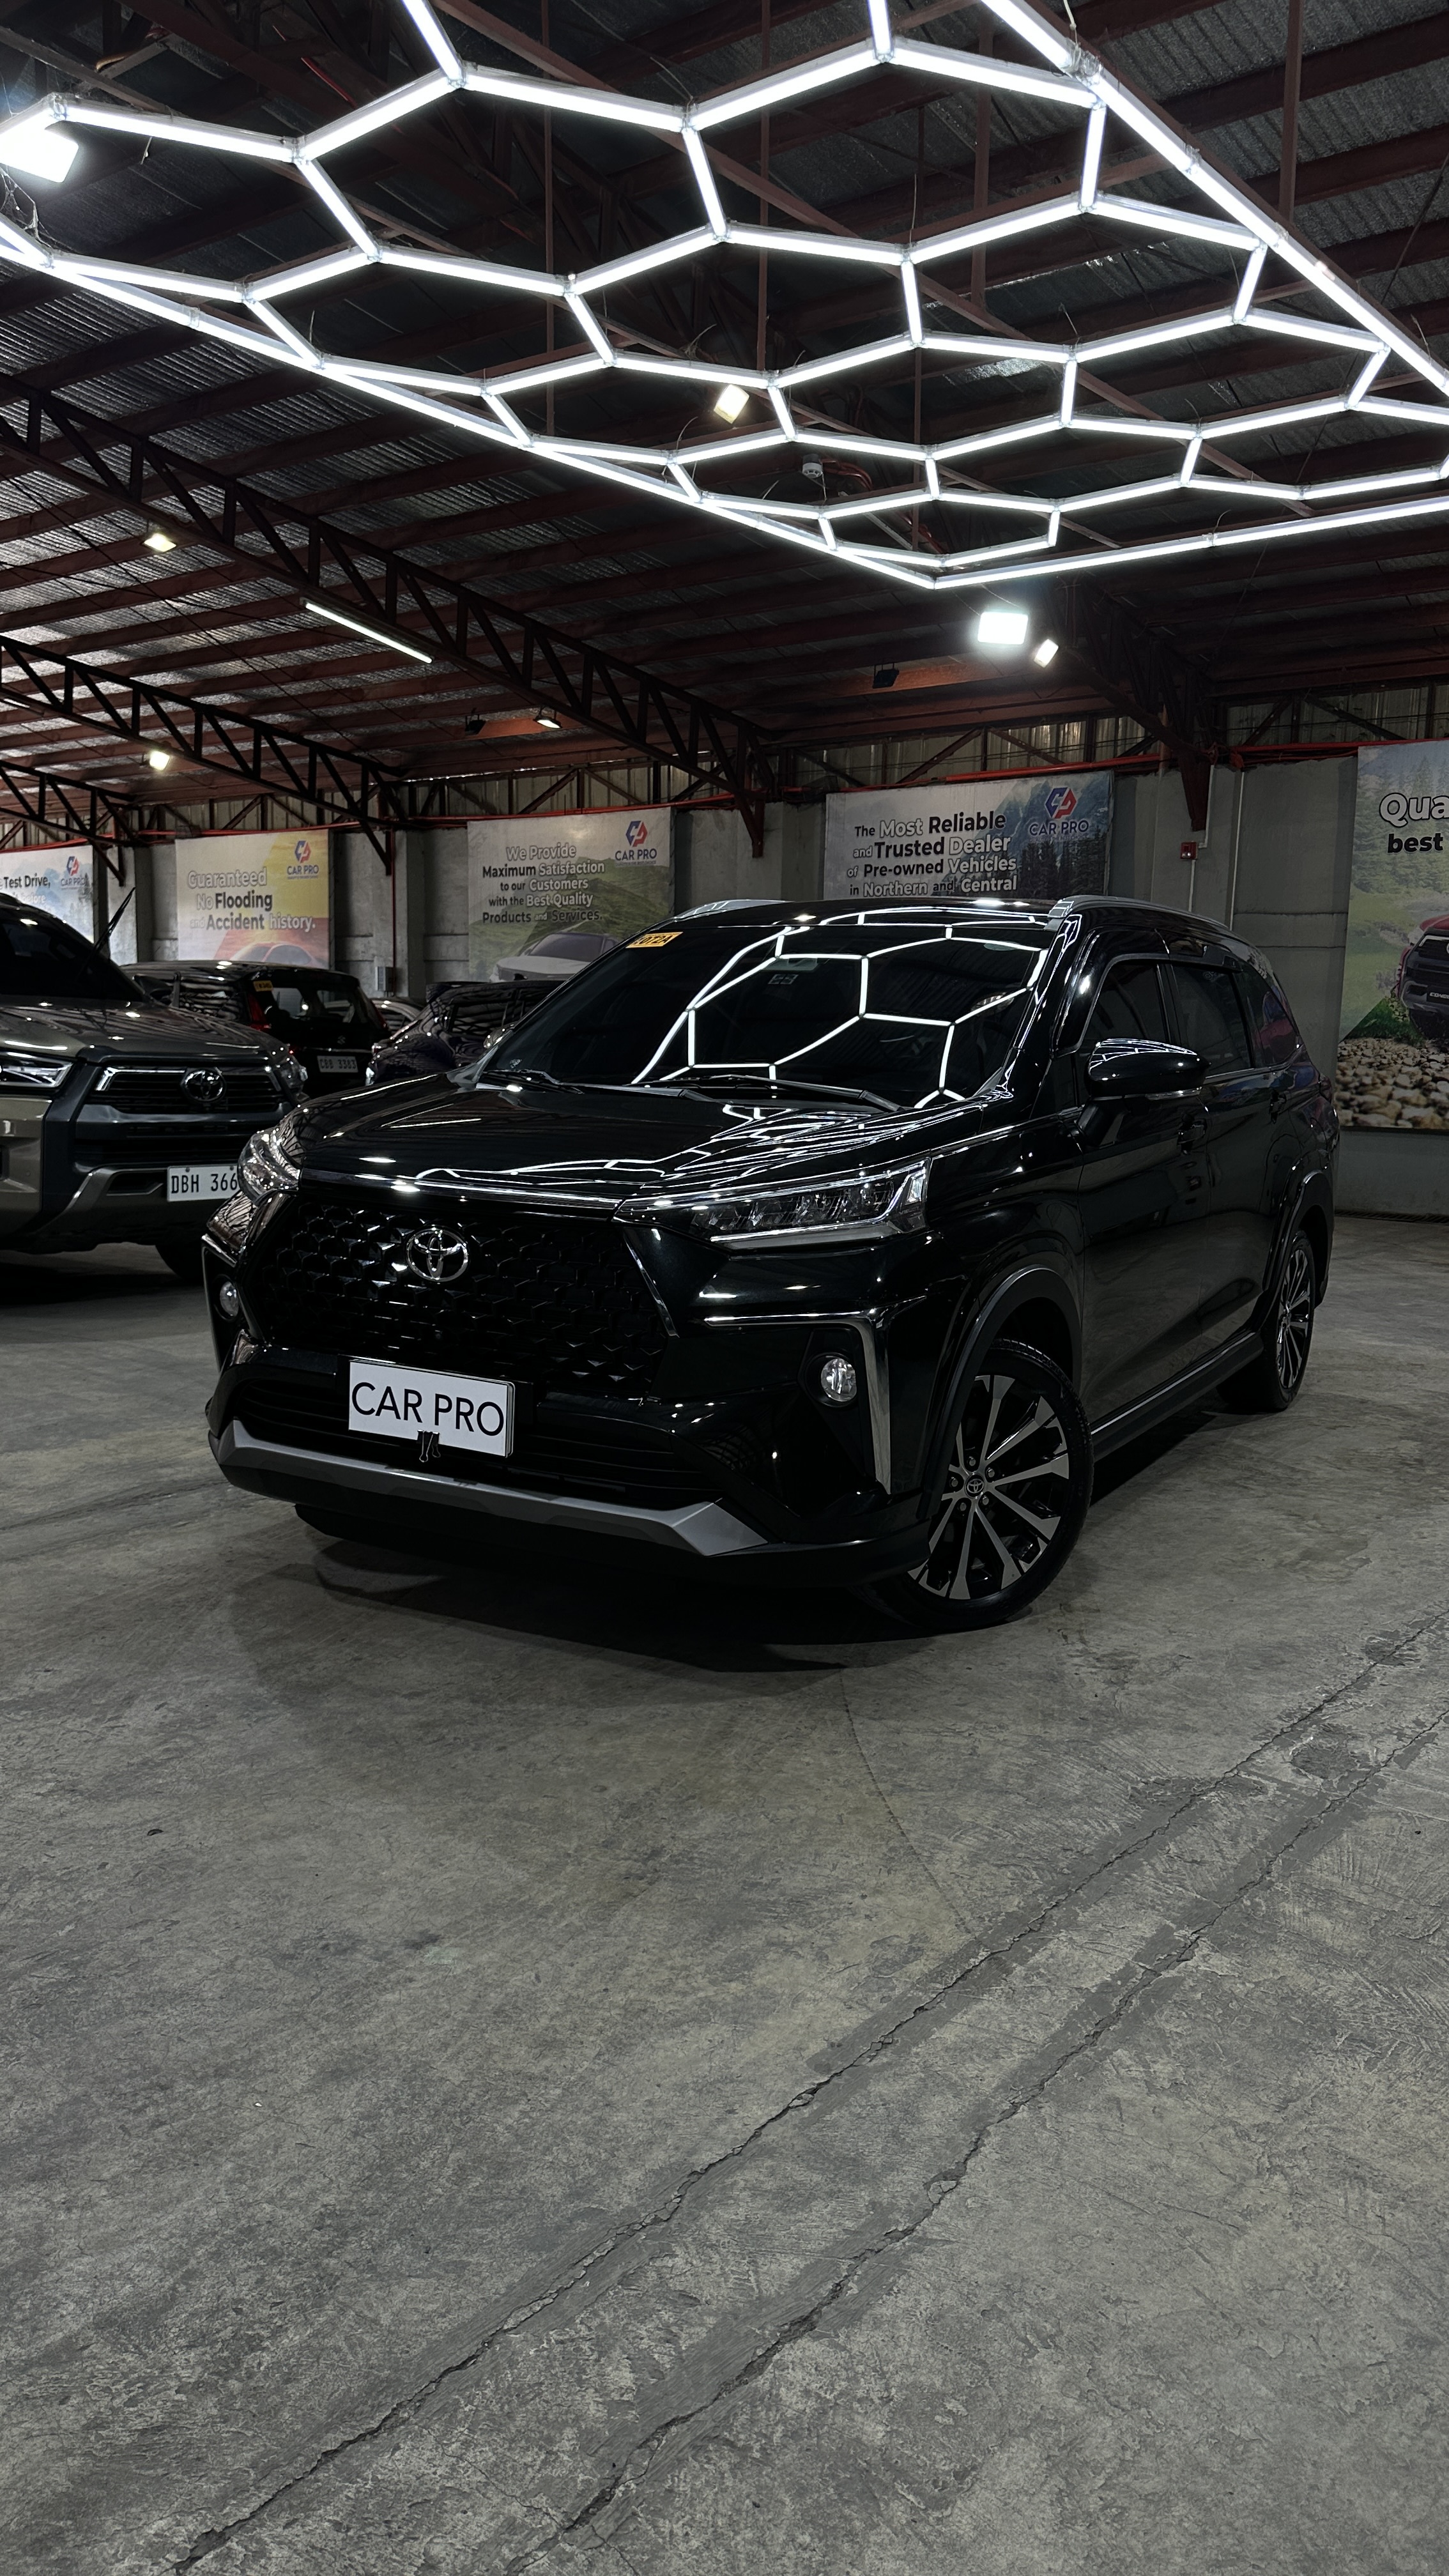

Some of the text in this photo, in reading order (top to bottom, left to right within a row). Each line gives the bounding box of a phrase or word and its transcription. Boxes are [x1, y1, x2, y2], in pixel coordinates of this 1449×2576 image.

[1379, 792, 1449, 828] Qua
[855, 811, 1006, 838] The Most Reliable
[1029, 820, 1089, 836] CAR PRO
[505, 842, 577, 861] We Provide
[853, 834, 1011, 858] and Trusted Dealer
[1388, 833, 1443, 853] best
[615, 848, 657, 861] CAR PRO
[287, 864, 319, 875] CAR PRO
[482, 860, 605, 878] Maximum Satisfaction
[847, 855, 1016, 878] of Pre-owned Vehicles
[4, 877, 22, 888] Test
[24, 873, 50, 888] Drive,
[188, 866, 267, 889] Guaranteed
[500, 878, 589, 892] to our Customers
[850, 875, 1018, 898] in Northern and Central
[196, 889, 273, 911] No Flooding
[489, 892, 594, 908] with the Best Quality
[190, 912, 316, 932] and Accident history.
[482, 911, 532, 924] Products
[552, 907, 602, 921] Services.
[171, 1174, 199, 1194] DBH
[351, 1382, 504, 1436] CAR PRO
